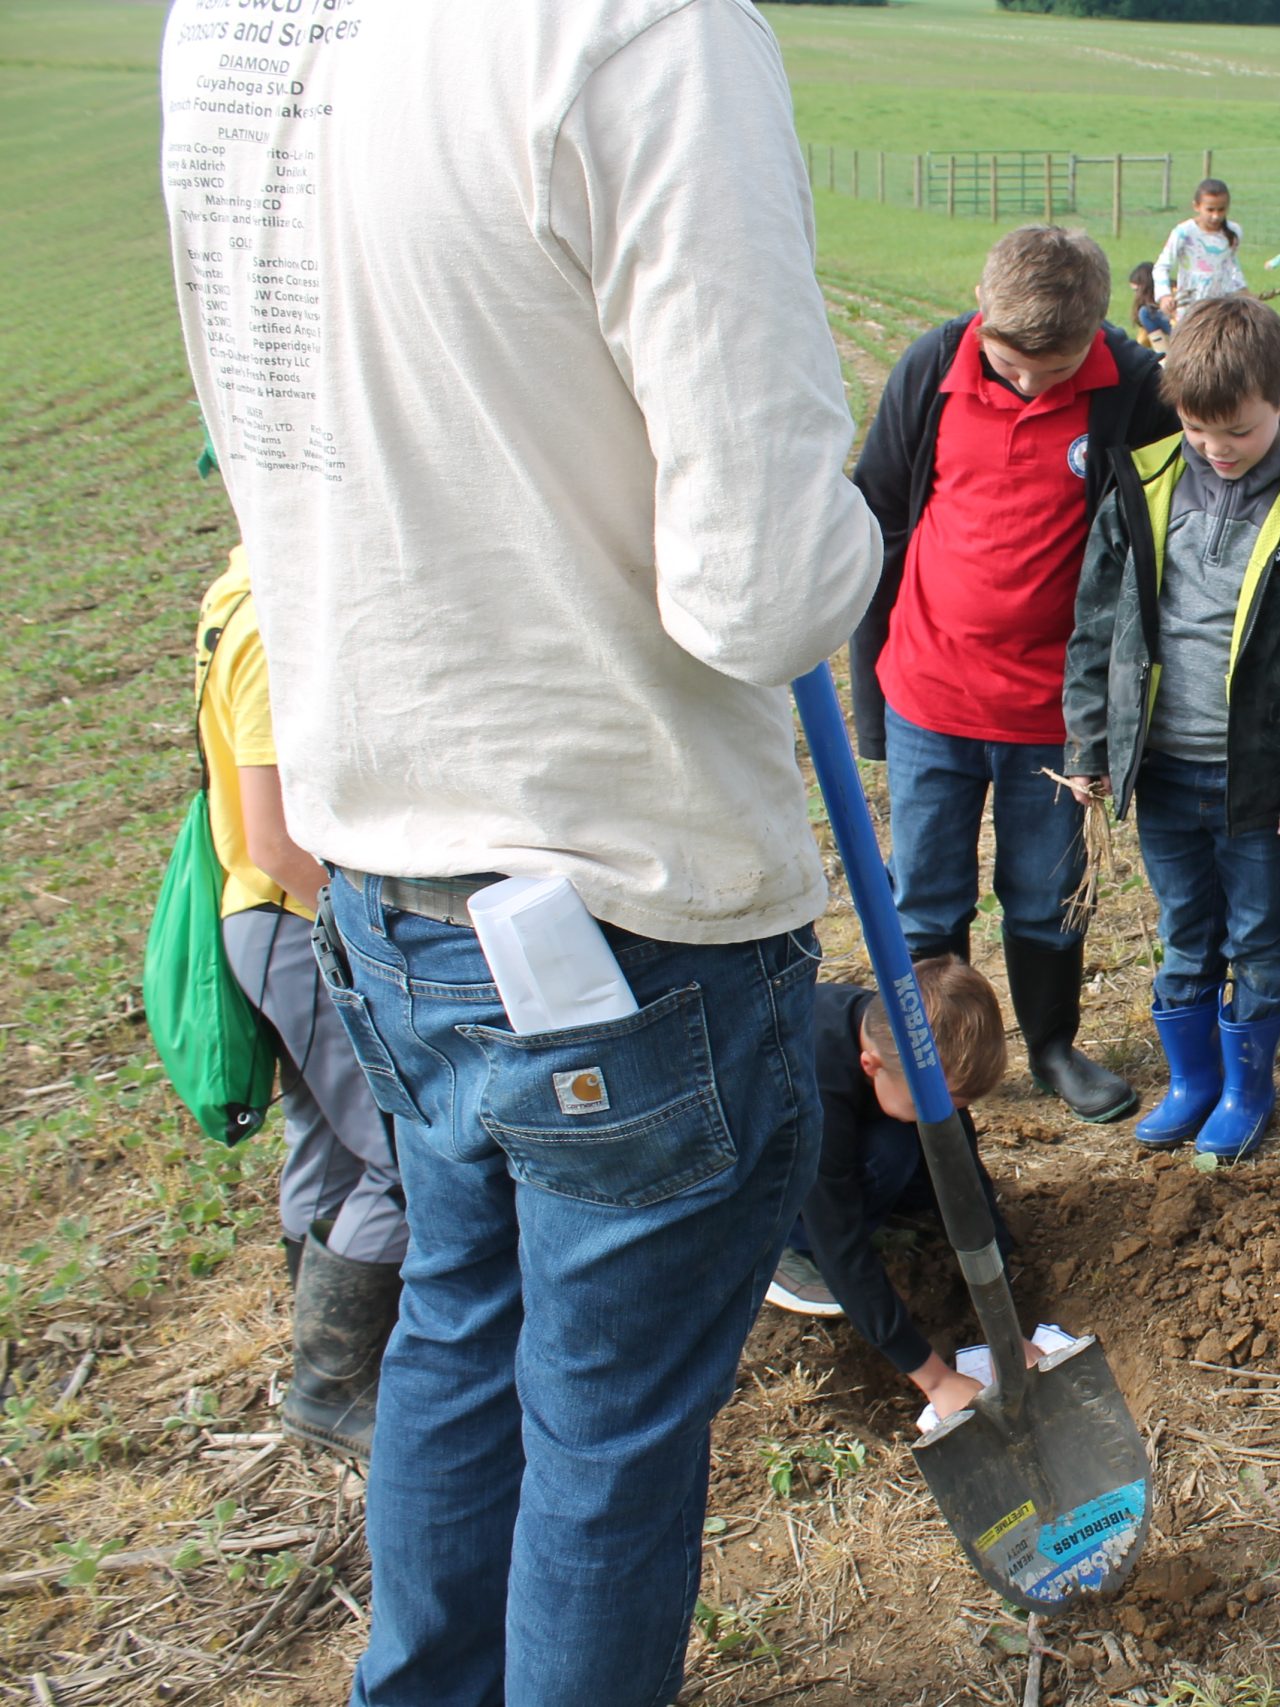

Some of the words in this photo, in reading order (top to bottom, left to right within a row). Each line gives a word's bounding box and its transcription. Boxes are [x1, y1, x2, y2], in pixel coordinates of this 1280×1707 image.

[233, 20, 274, 44] and
[218, 53, 290, 75] DIAMOND
[196, 75, 263, 96] Cuyahoga
[193, 97, 273, 118] Foundation
[189, 160, 226, 171] Aldrich
[194, 177, 225, 188] SWCD
[270, 307, 302, 320] Davey
[266, 387, 317, 400] Hardware
[893, 972, 937, 1069] KOBALT
[995, 1505, 1030, 1535] LIFETIME
